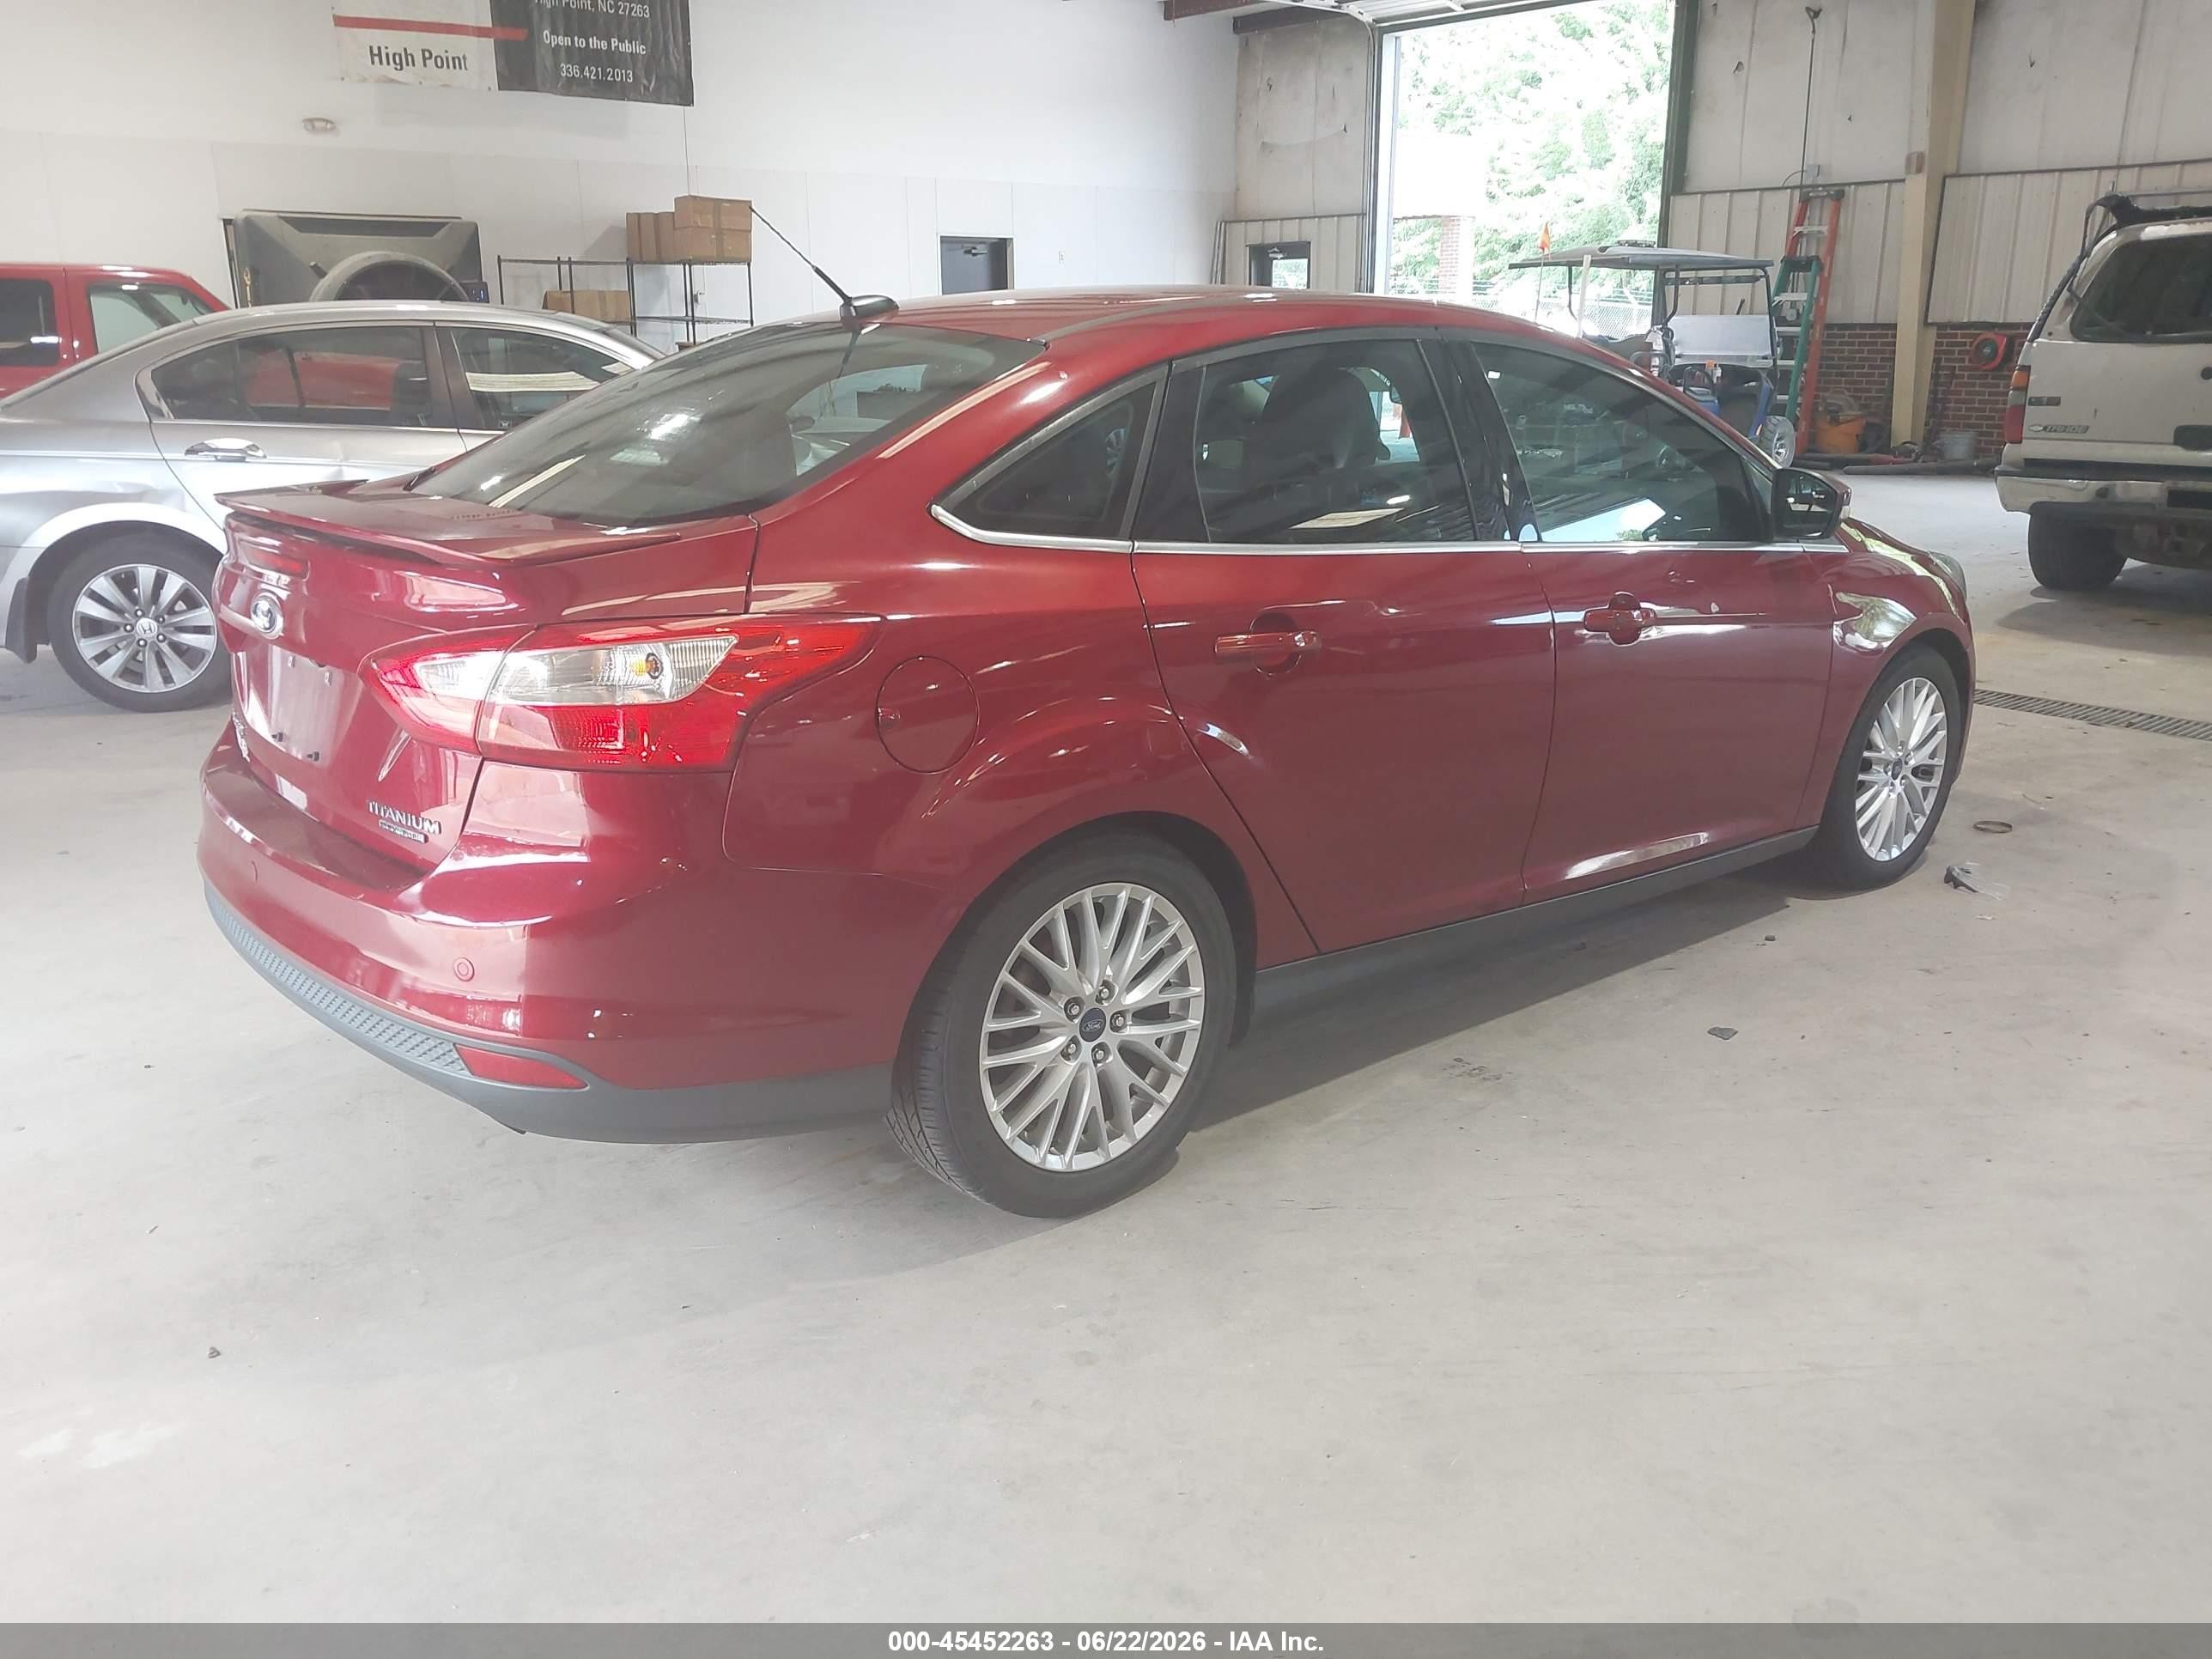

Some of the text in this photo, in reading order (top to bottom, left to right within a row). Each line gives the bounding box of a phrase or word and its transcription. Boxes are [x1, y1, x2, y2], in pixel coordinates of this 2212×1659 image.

[598, 0, 616, 14] NC
[617, 1, 650, 18] 27263
[543, 29, 647, 55] Open to the Public
[369, 45, 468, 71] High Point
[560, 63, 633, 83] 336.421.2013
